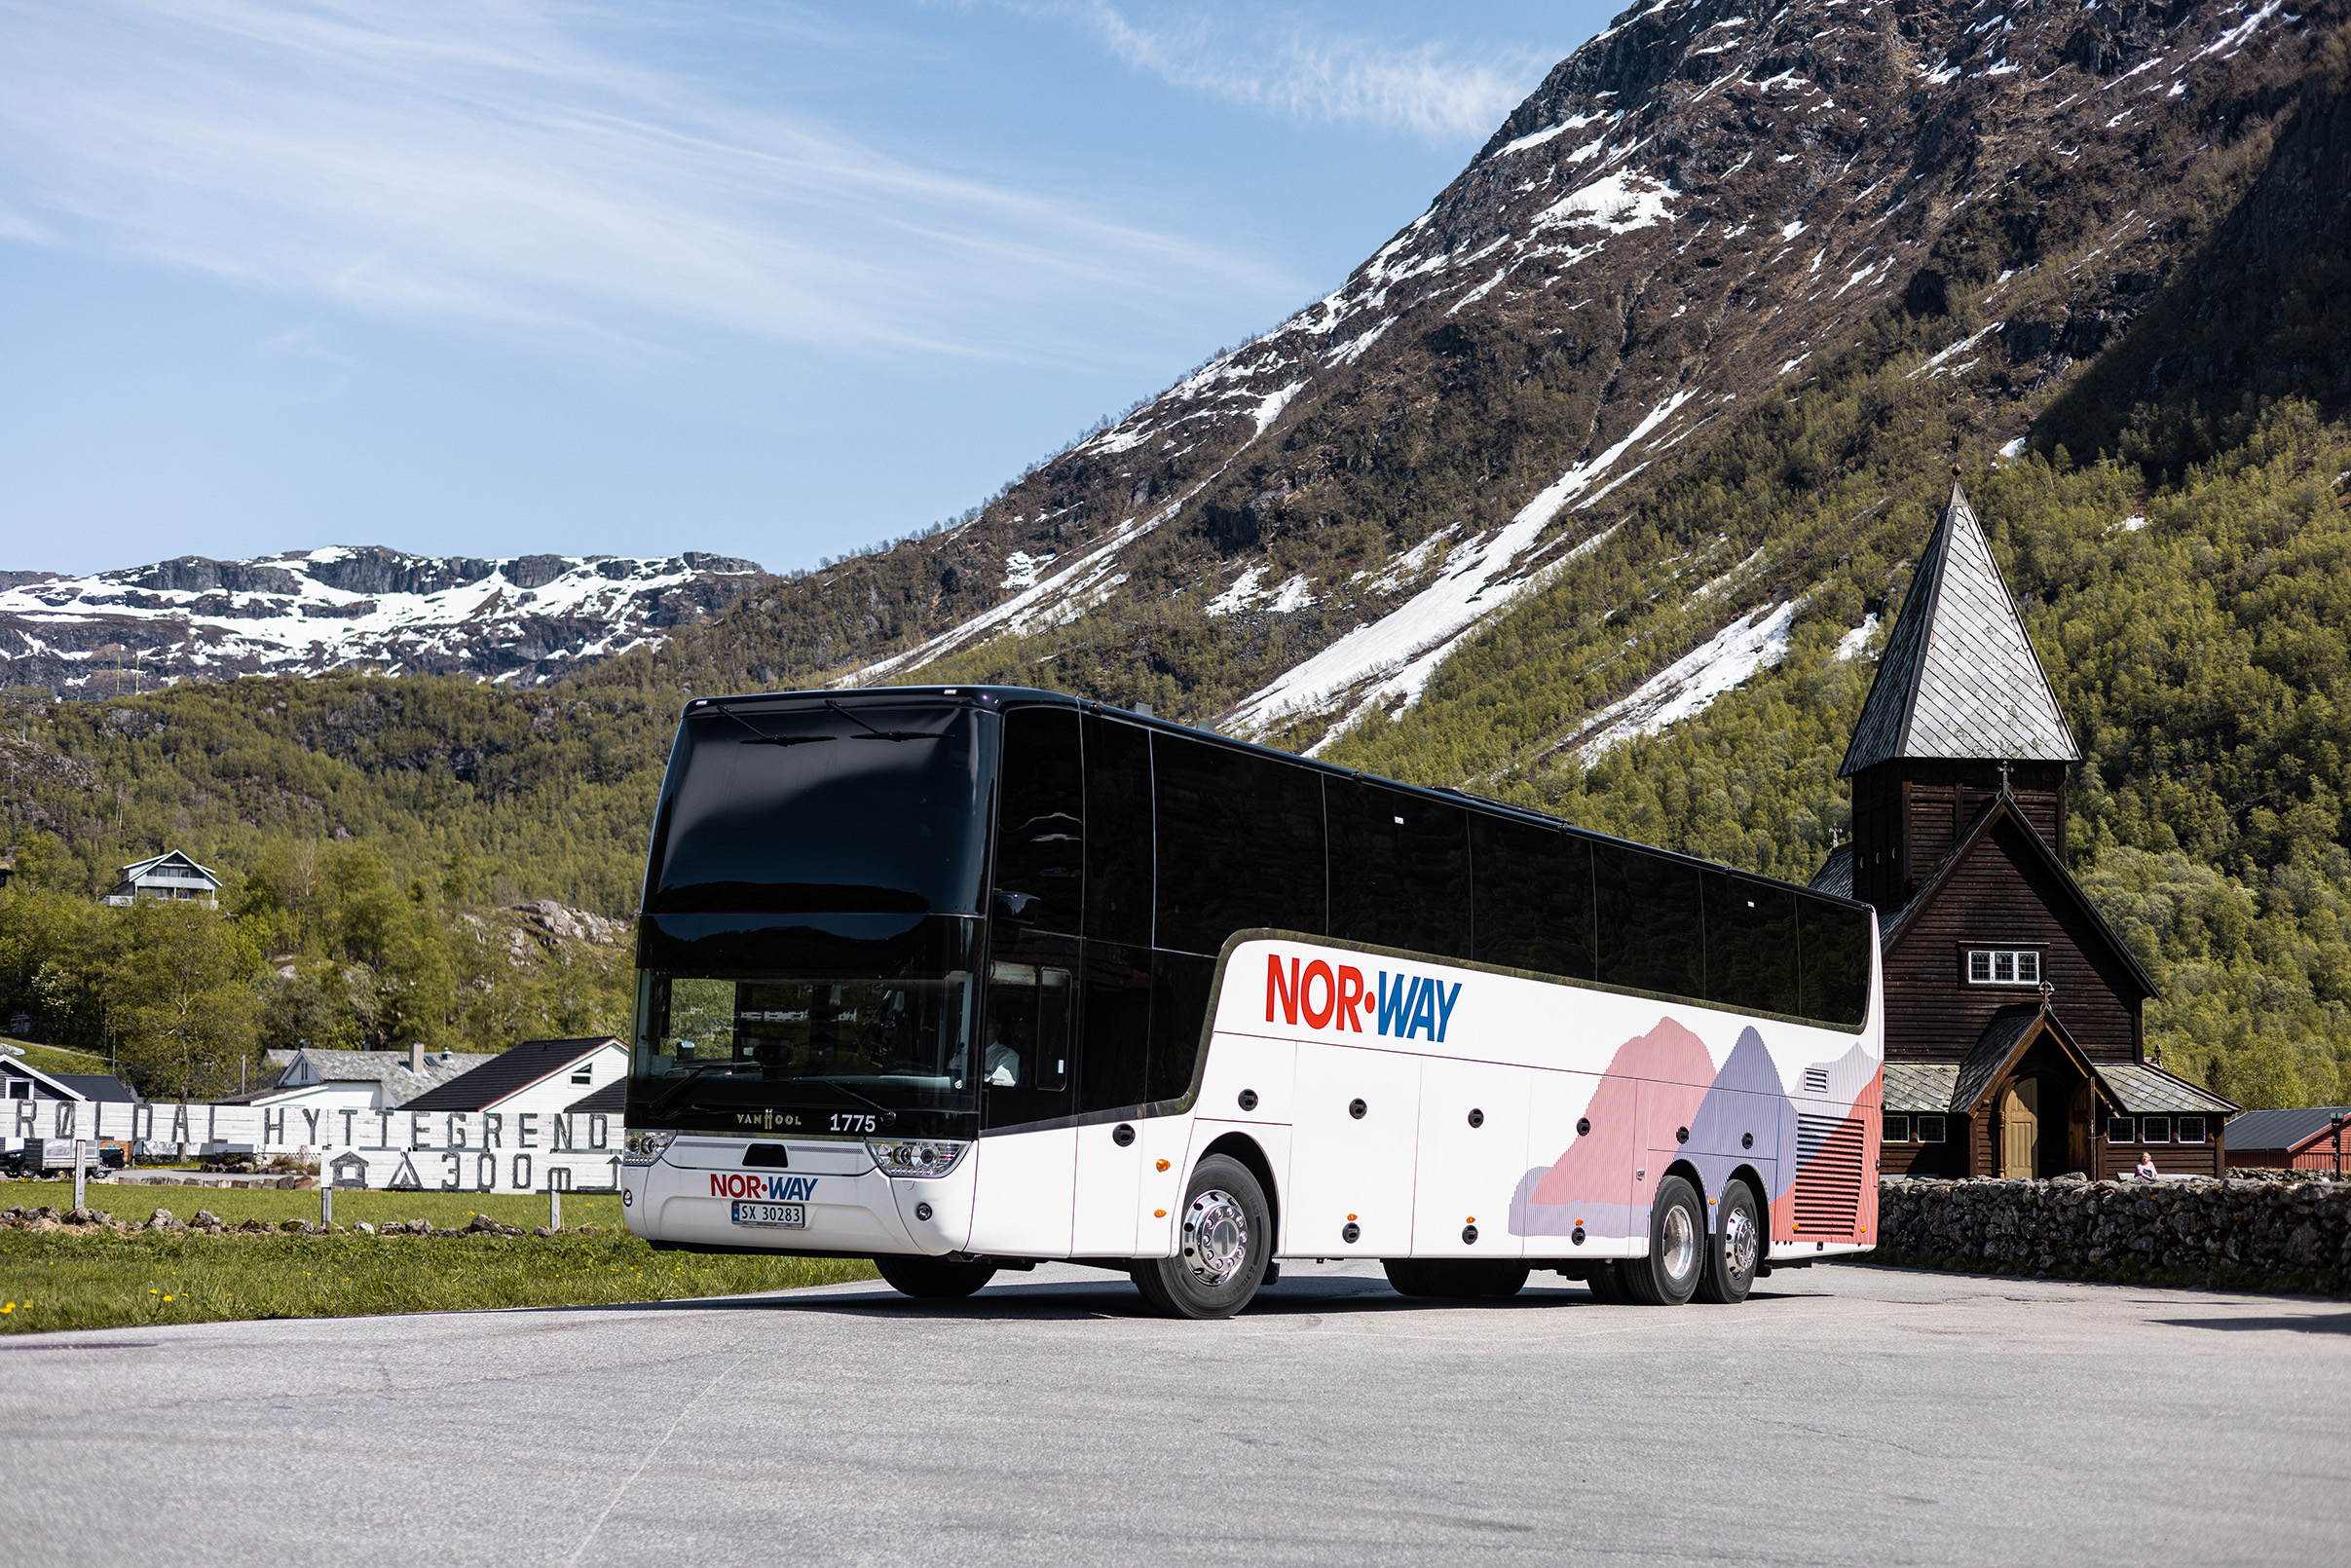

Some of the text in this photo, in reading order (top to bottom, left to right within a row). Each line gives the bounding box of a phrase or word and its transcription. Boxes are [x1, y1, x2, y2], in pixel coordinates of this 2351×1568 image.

[16, 1100, 608, 1149] RØLDAL HYTTEGREND
[830, 1113, 877, 1133] 1775
[441, 1151, 532, 1190] 300
[741, 1206, 801, 1222] SX 30283
